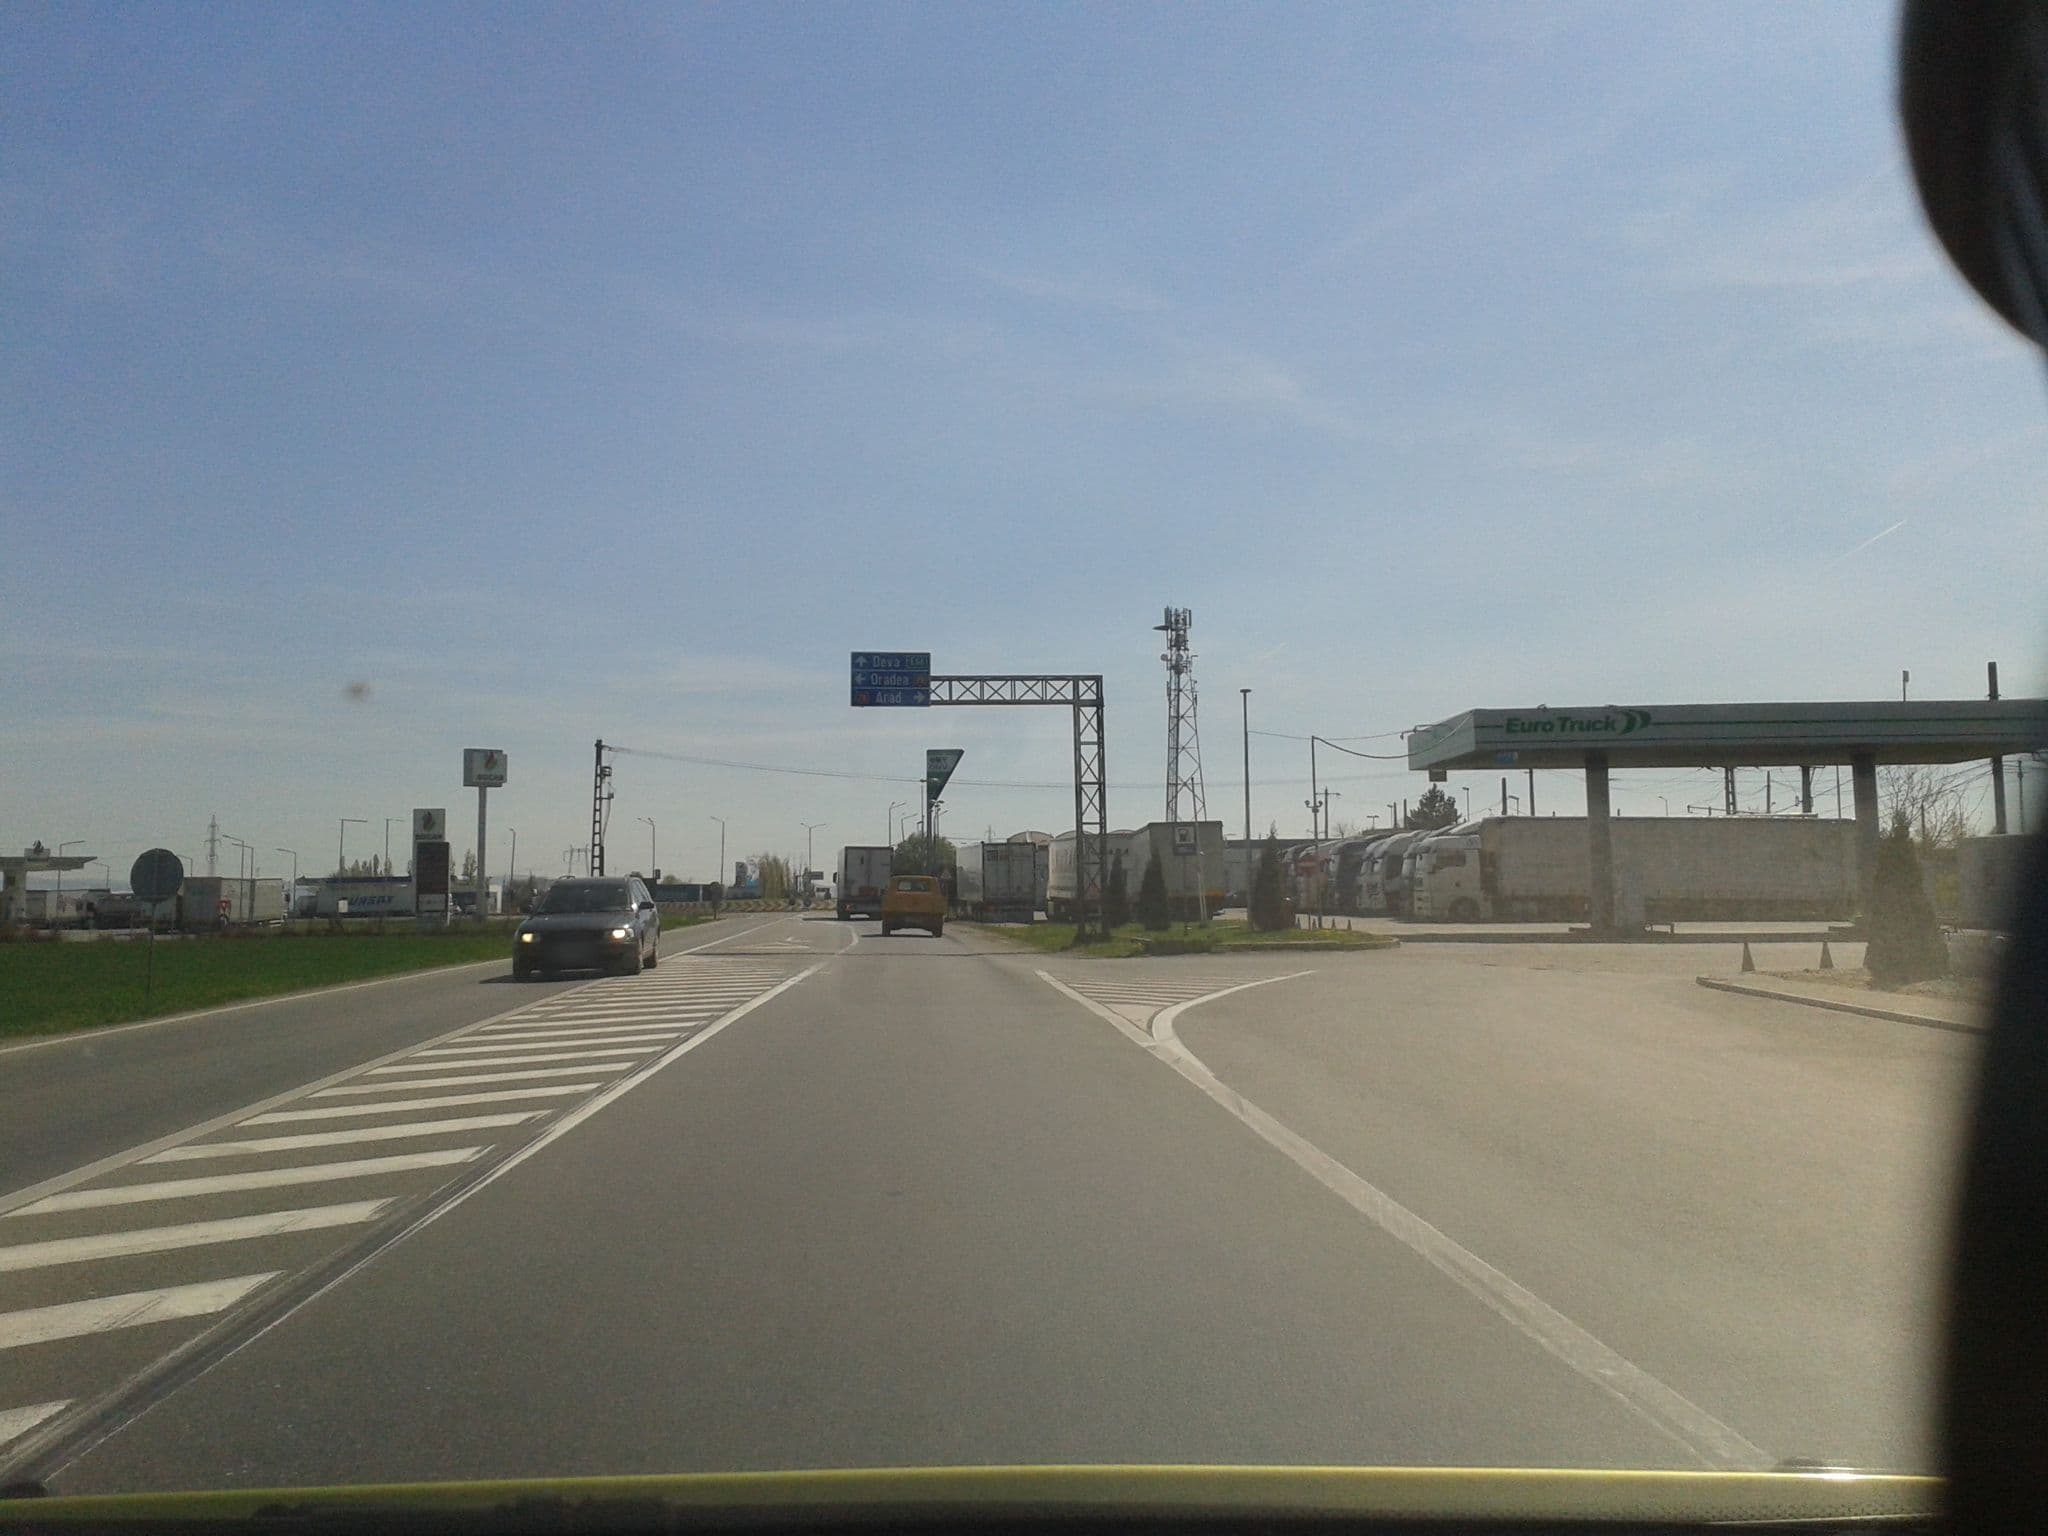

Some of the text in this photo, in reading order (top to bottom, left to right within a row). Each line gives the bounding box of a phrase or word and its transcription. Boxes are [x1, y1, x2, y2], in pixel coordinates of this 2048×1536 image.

[872, 655, 901, 668] Deva
[870, 672, 910, 686] Oradea
[876, 690, 902, 704] Arad
[1505, 714, 1616, 734] Euro Truck
